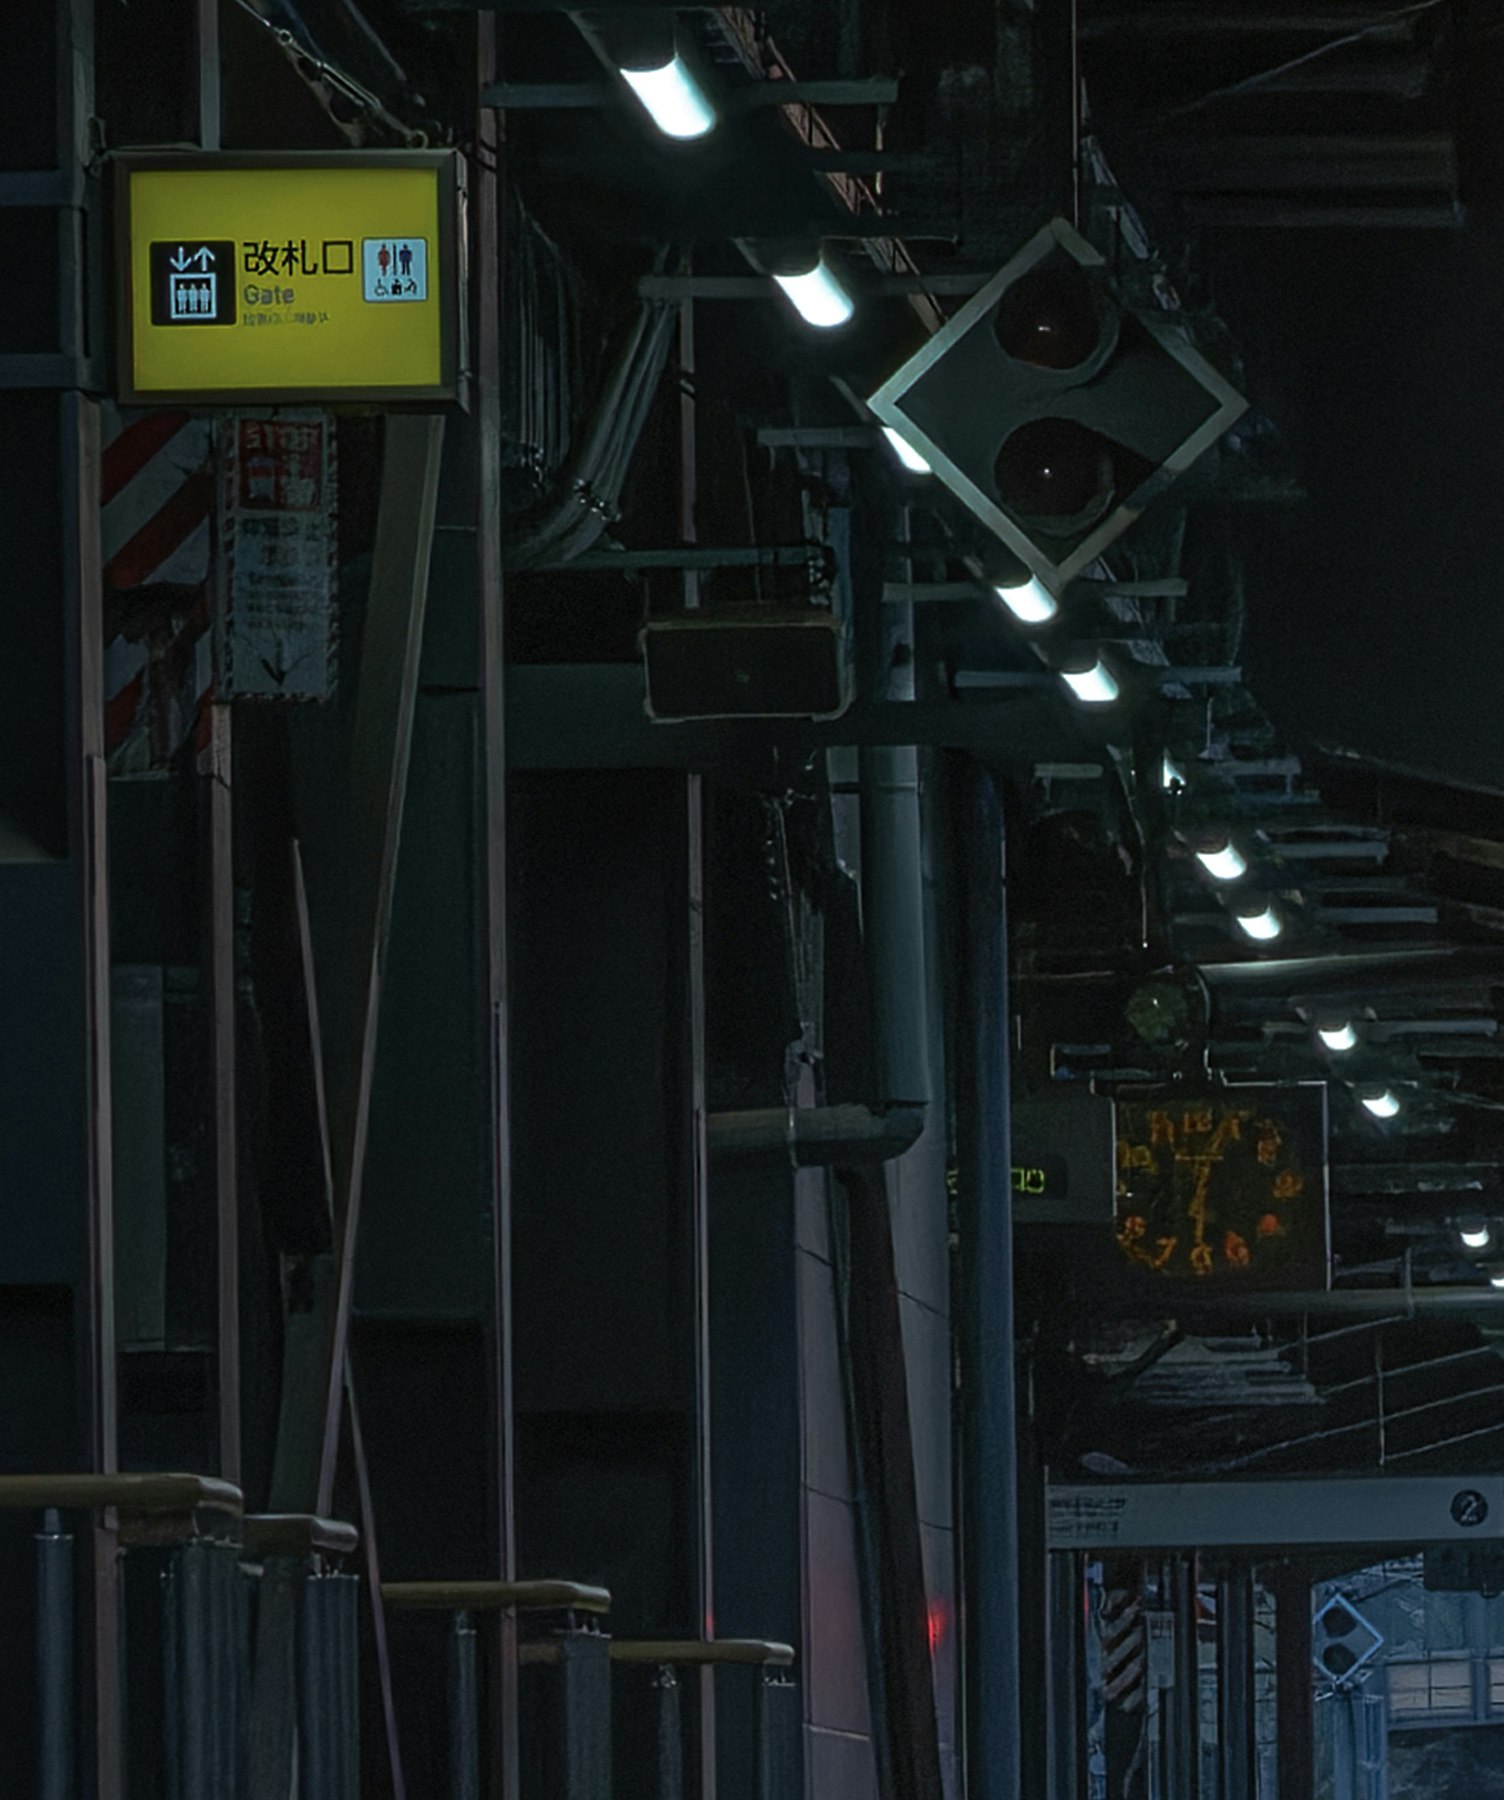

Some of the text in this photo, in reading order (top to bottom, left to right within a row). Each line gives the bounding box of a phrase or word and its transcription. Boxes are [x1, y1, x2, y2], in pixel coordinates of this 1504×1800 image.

[242, 239, 354, 277] 改札口
[243, 284, 295, 305] Gate
